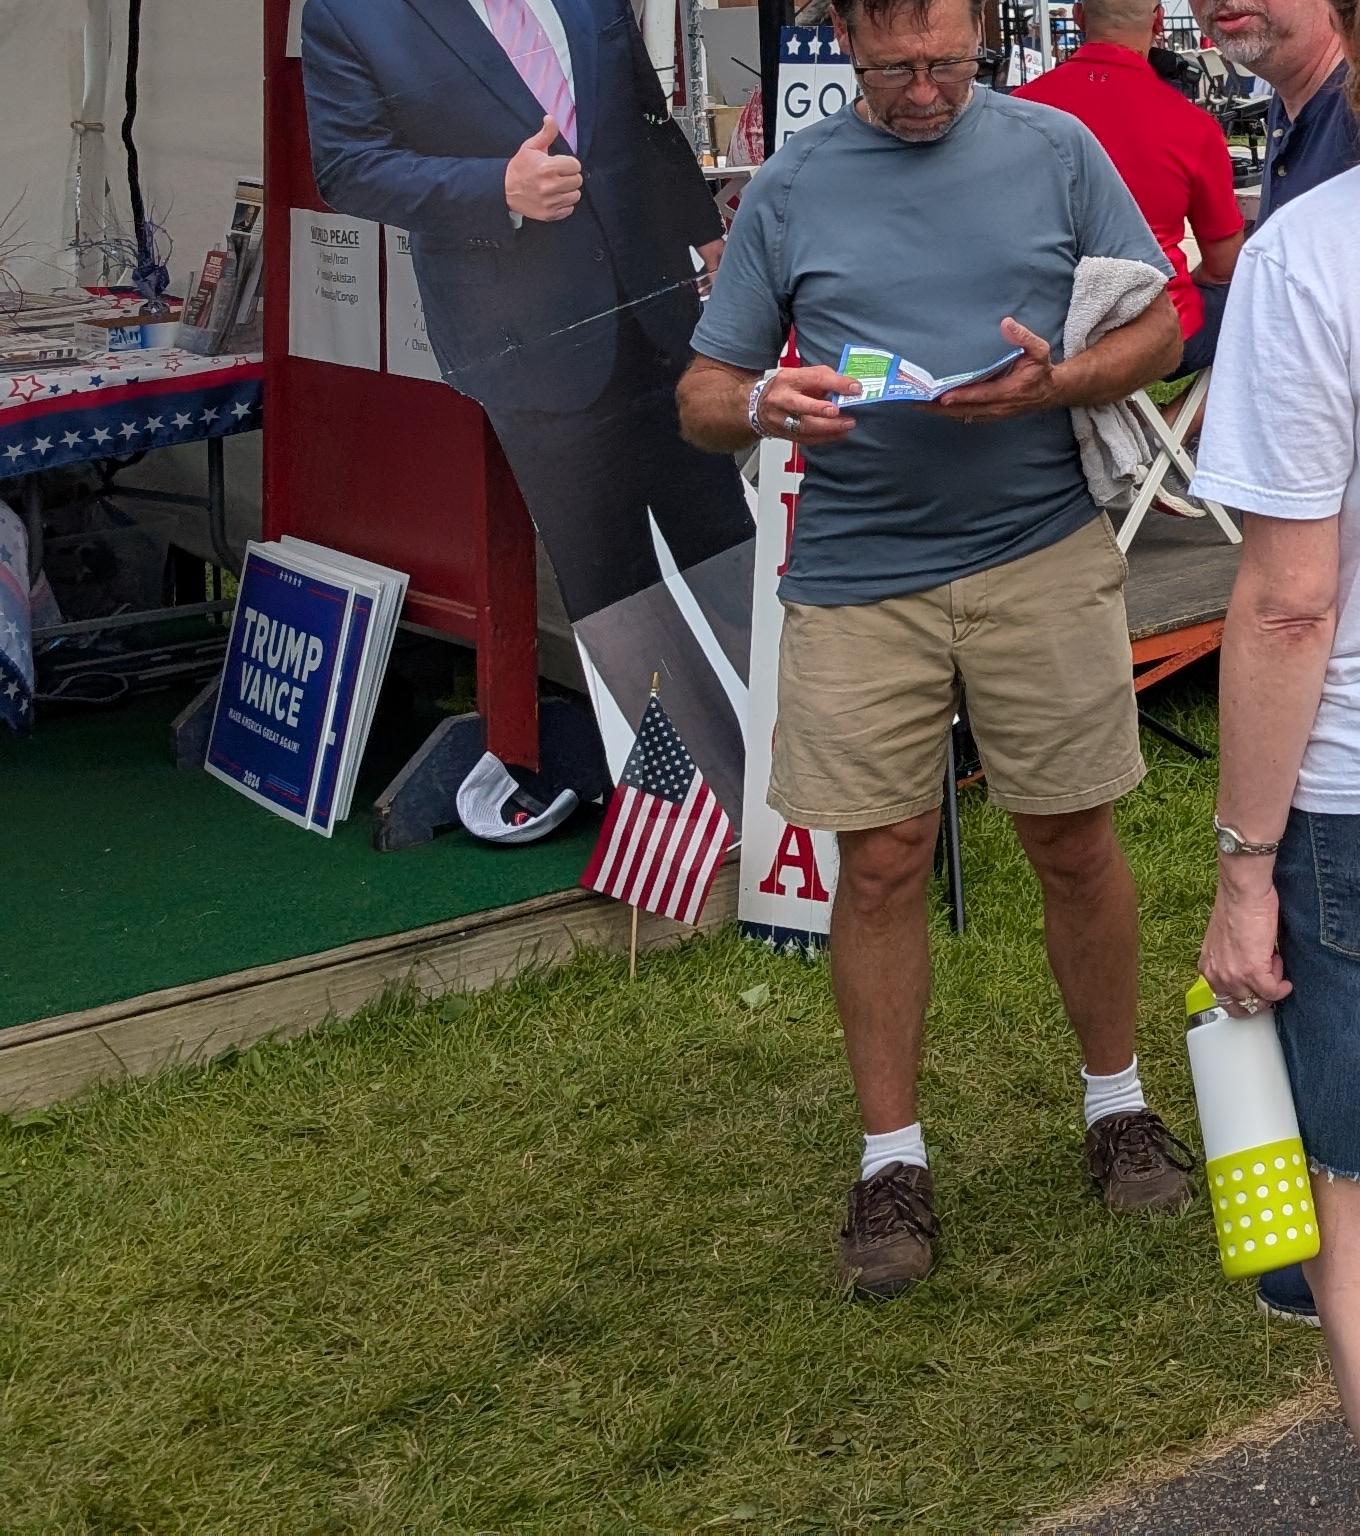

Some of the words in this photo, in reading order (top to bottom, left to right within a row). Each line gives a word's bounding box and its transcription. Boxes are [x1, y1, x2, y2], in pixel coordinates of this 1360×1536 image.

[329, 229, 360, 246] PEACE
[241, 606, 324, 684] TRUMP
[238, 661, 304, 729] VANCE
[242, 769, 261, 790] 2024
